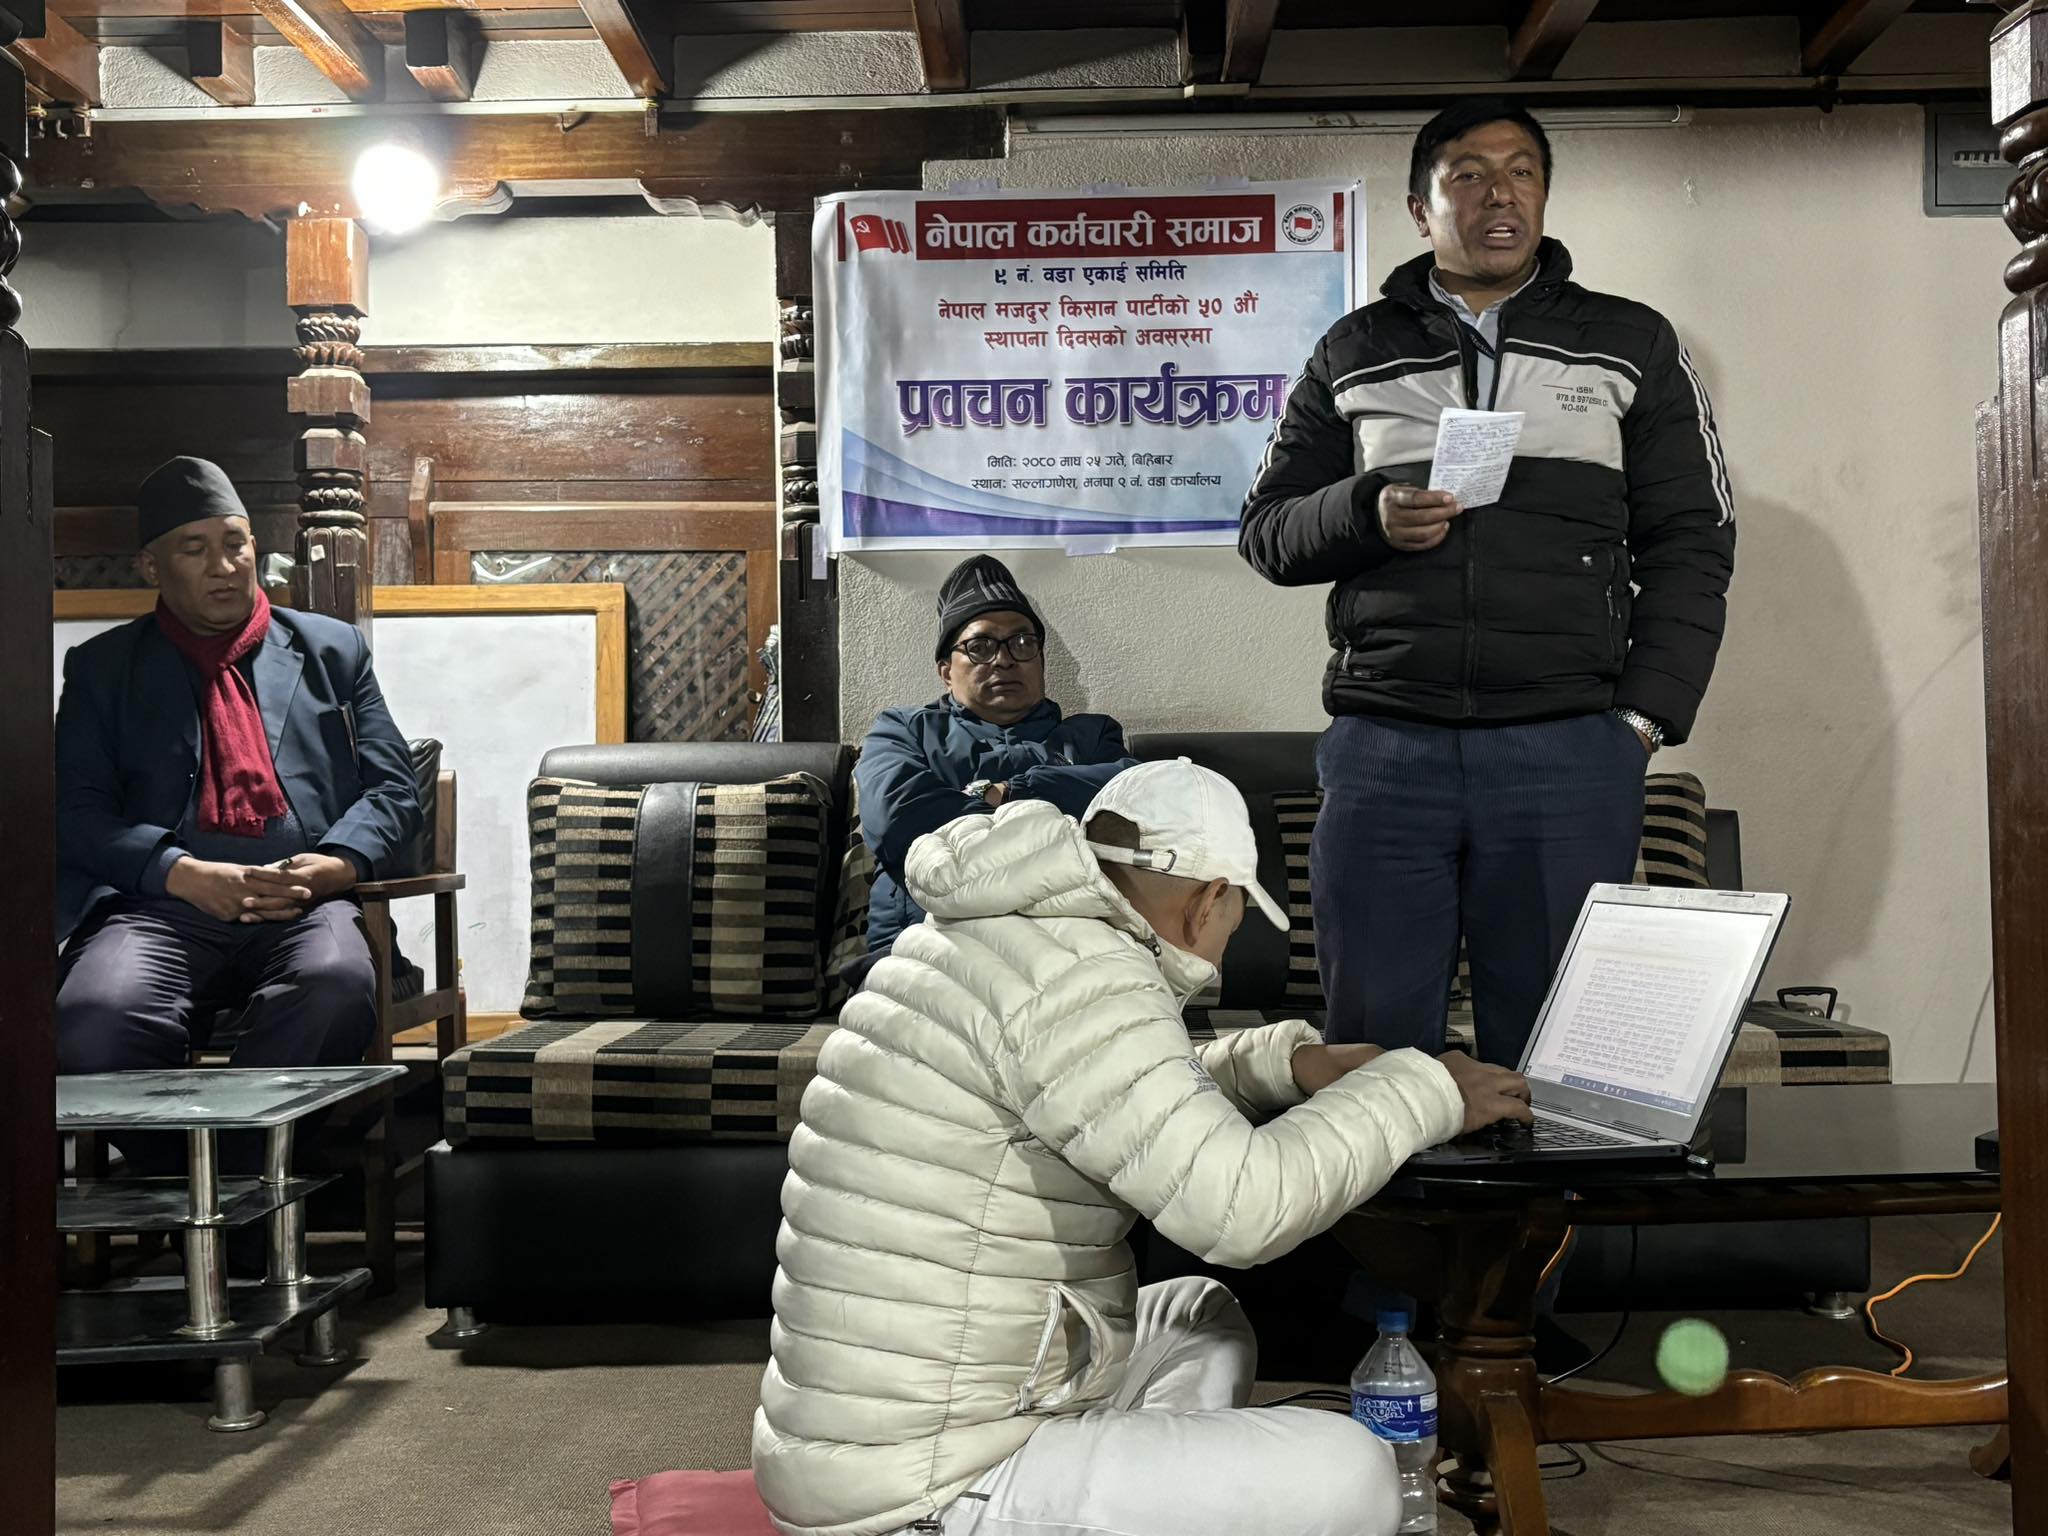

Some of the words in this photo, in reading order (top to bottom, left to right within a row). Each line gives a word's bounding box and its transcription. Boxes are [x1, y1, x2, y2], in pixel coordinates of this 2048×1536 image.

[925, 213, 1017, 249] नेपाल
[1027, 212, 1155, 248] कर्मचारी
[1166, 216, 1263, 248] समाज
[1042, 266, 1075, 283] वडा
[1082, 261, 1129, 286] एकाई
[1135, 260, 1188, 283] समिति
[938, 298, 987, 321] नेपाल
[995, 301, 1051, 325] मजदुर
[1059, 294, 1118, 319] किसान
[1126, 293, 1190, 317] पार्टीको
[1198, 297, 1223, 318] ५०
[984, 331, 1049, 350] स्थापना
[1056, 324, 1127, 349] दिवसको
[1135, 327, 1213, 348] अवसरमा
[895, 377, 1051, 438] प्रवचन
[1063, 361, 1288, 428] कार्यक्रम
[1576, 386, 1594, 394] ISBN
[1022, 456, 1056, 468] २०८०
[1059, 456, 1082, 467] माघ
[1131, 452, 1174, 467] बिहिबार
[1147, 476, 1167, 487] वडा
[1169, 471, 1222, 487] कार्यालय
